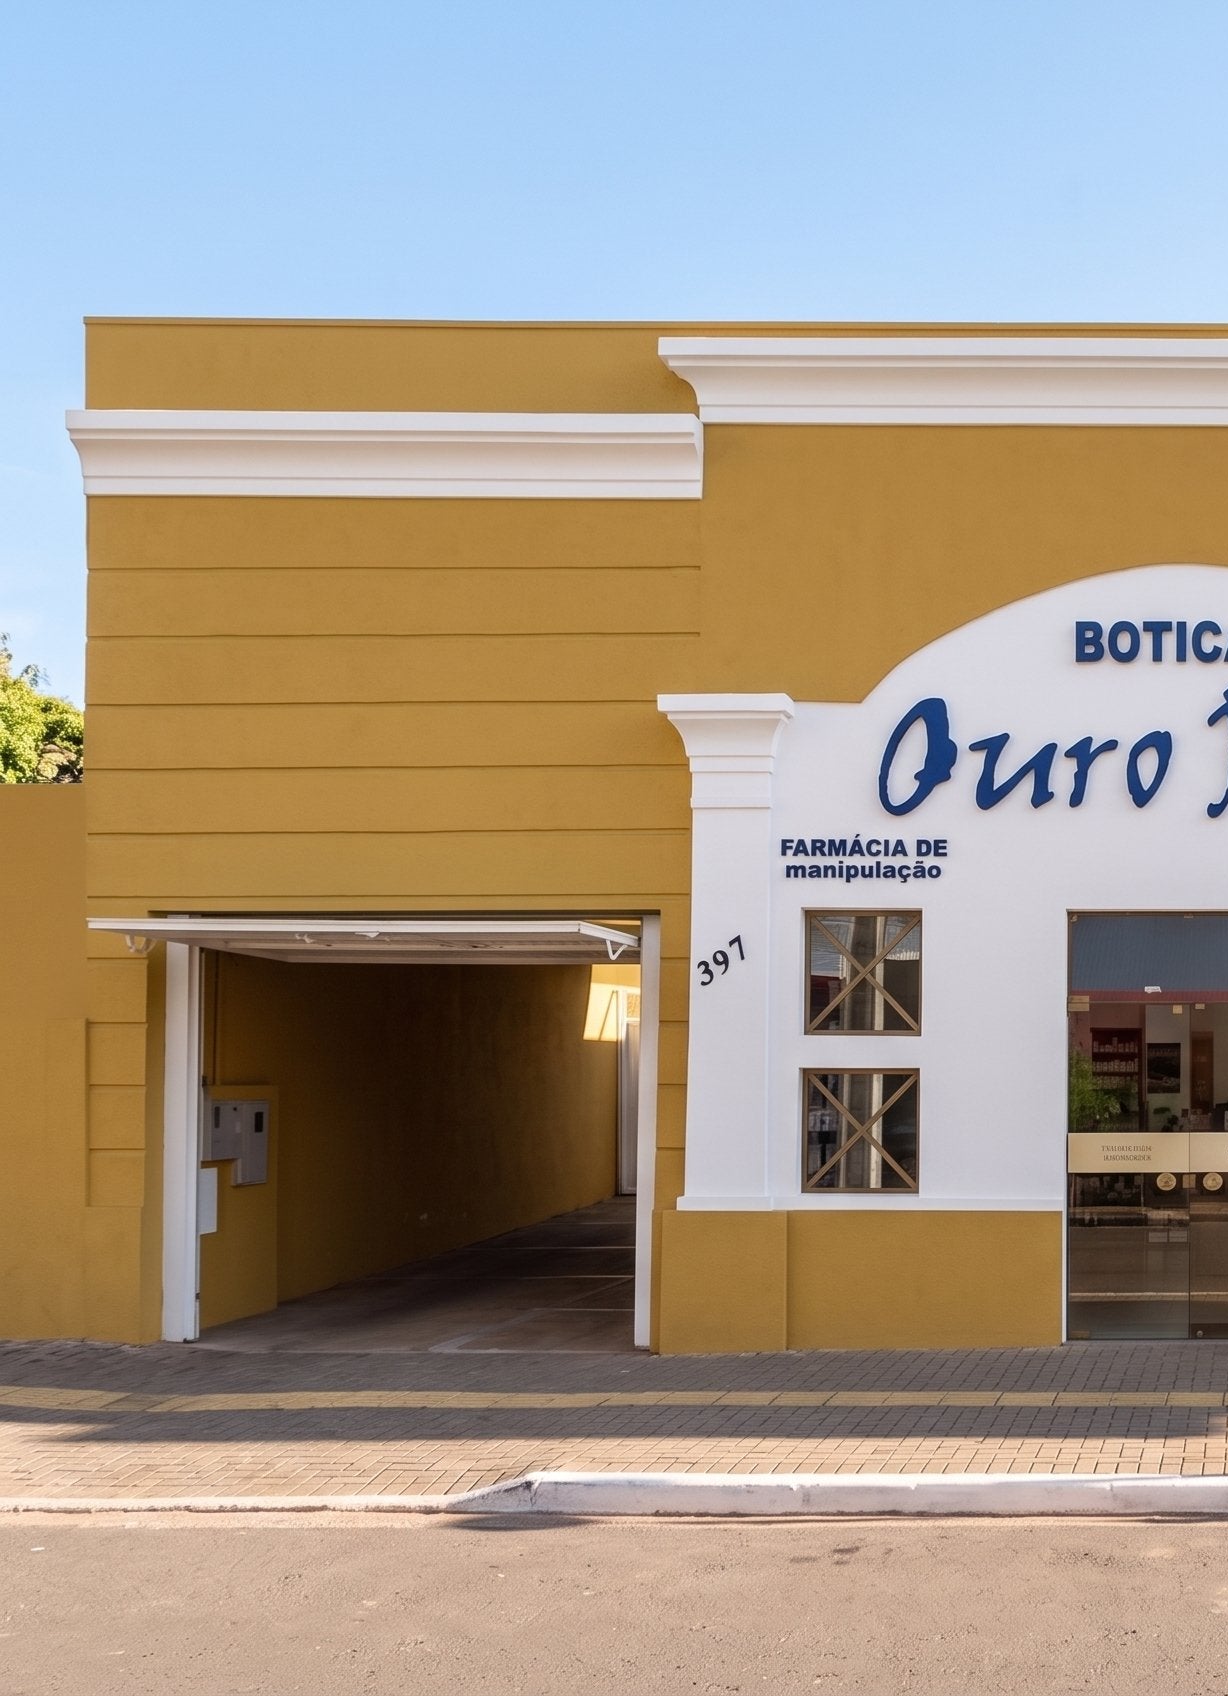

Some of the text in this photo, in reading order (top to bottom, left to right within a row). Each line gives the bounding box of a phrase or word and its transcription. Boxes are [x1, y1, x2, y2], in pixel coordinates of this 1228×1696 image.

[877, 697, 1173, 817] Ouro
[780, 834, 948, 857] FARMÁCIA DE
[785, 860, 942, 884] manipulação
[697, 934, 745, 987] 397
